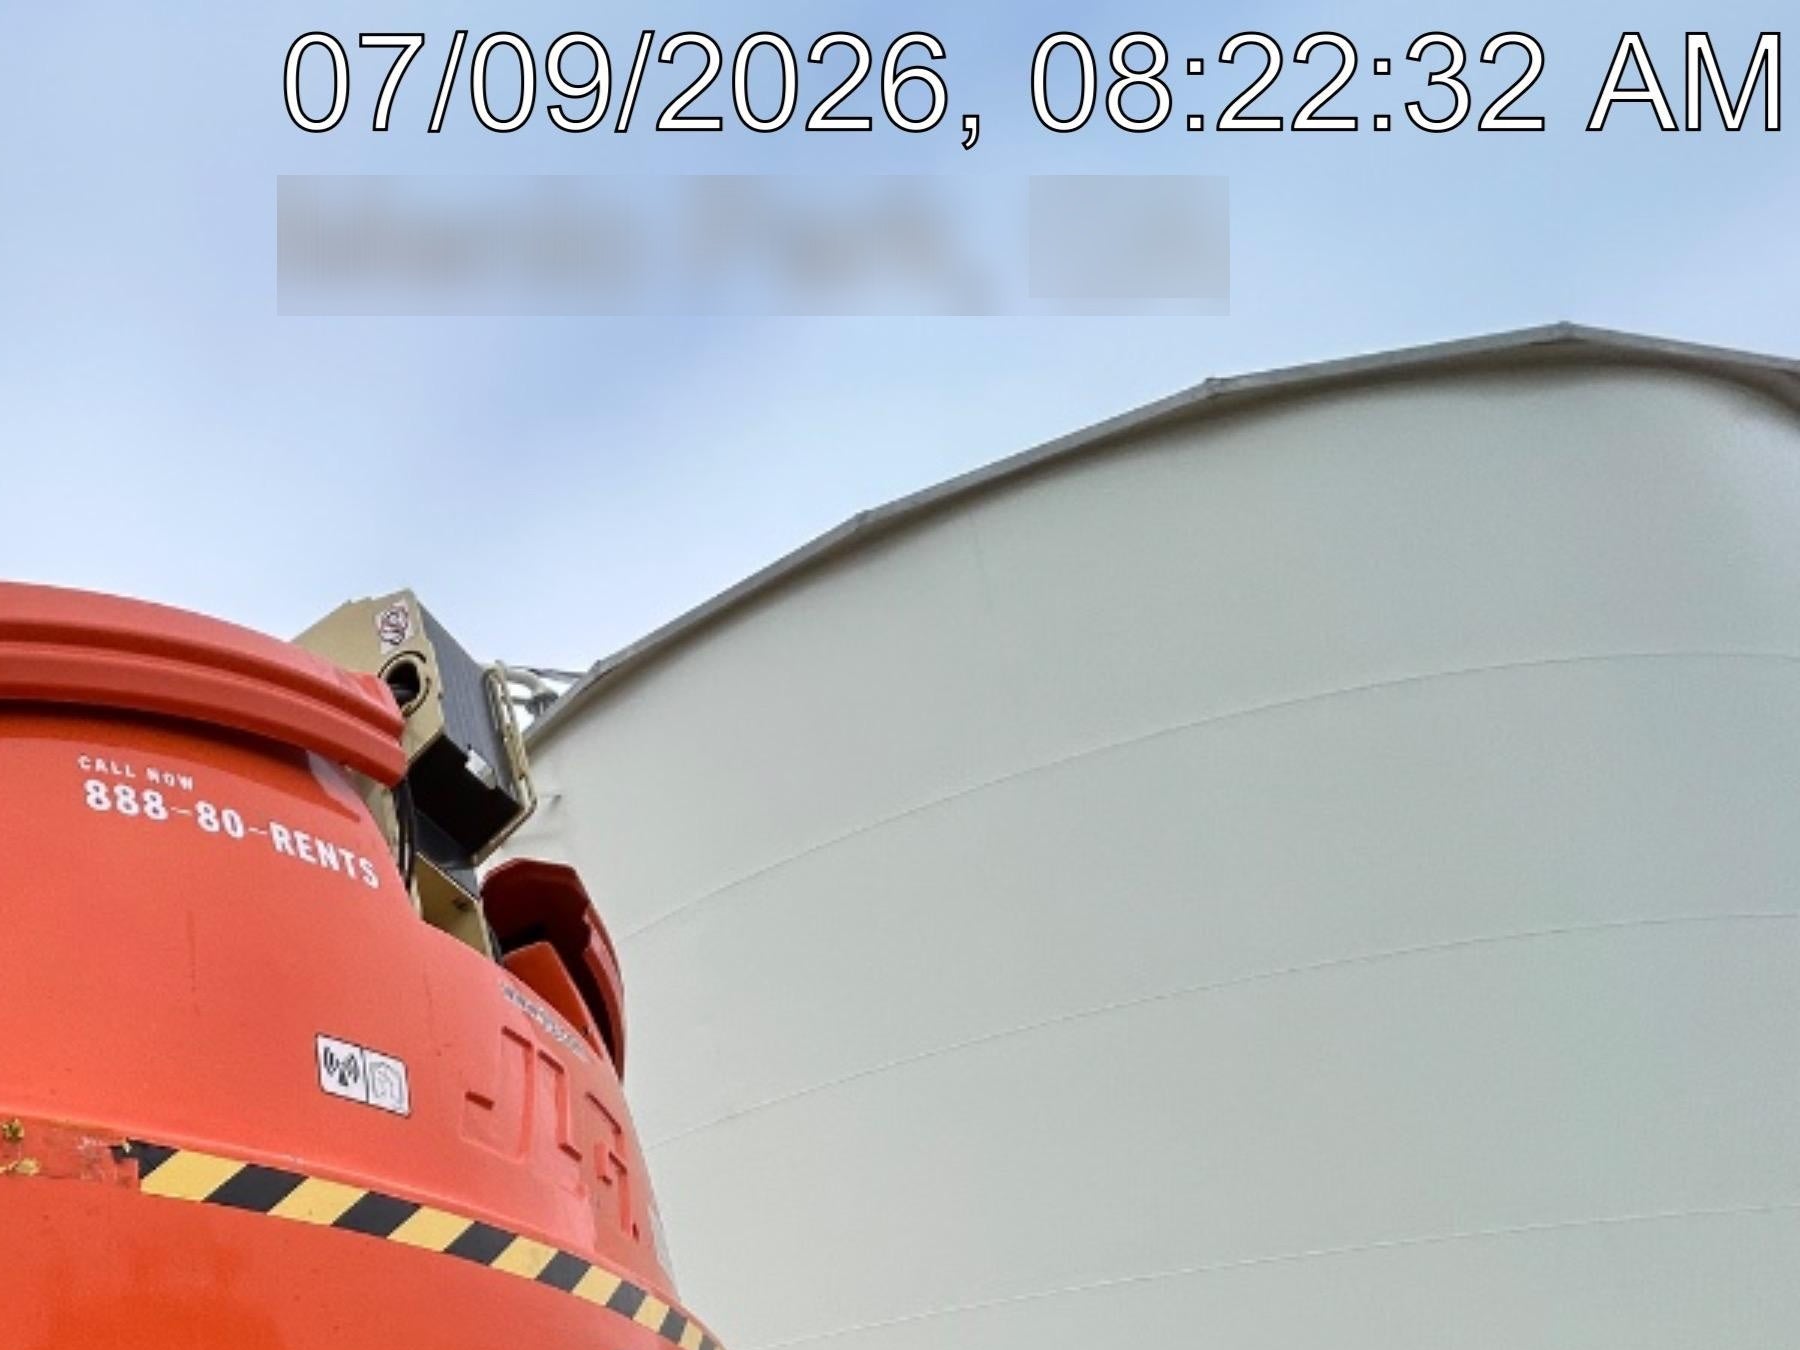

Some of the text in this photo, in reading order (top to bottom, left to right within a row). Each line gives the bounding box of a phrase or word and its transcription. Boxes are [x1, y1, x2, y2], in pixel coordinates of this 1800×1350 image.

[78, 754, 193, 791] CALL NOW
[83, 778, 380, 890] 888-80-RENTS
